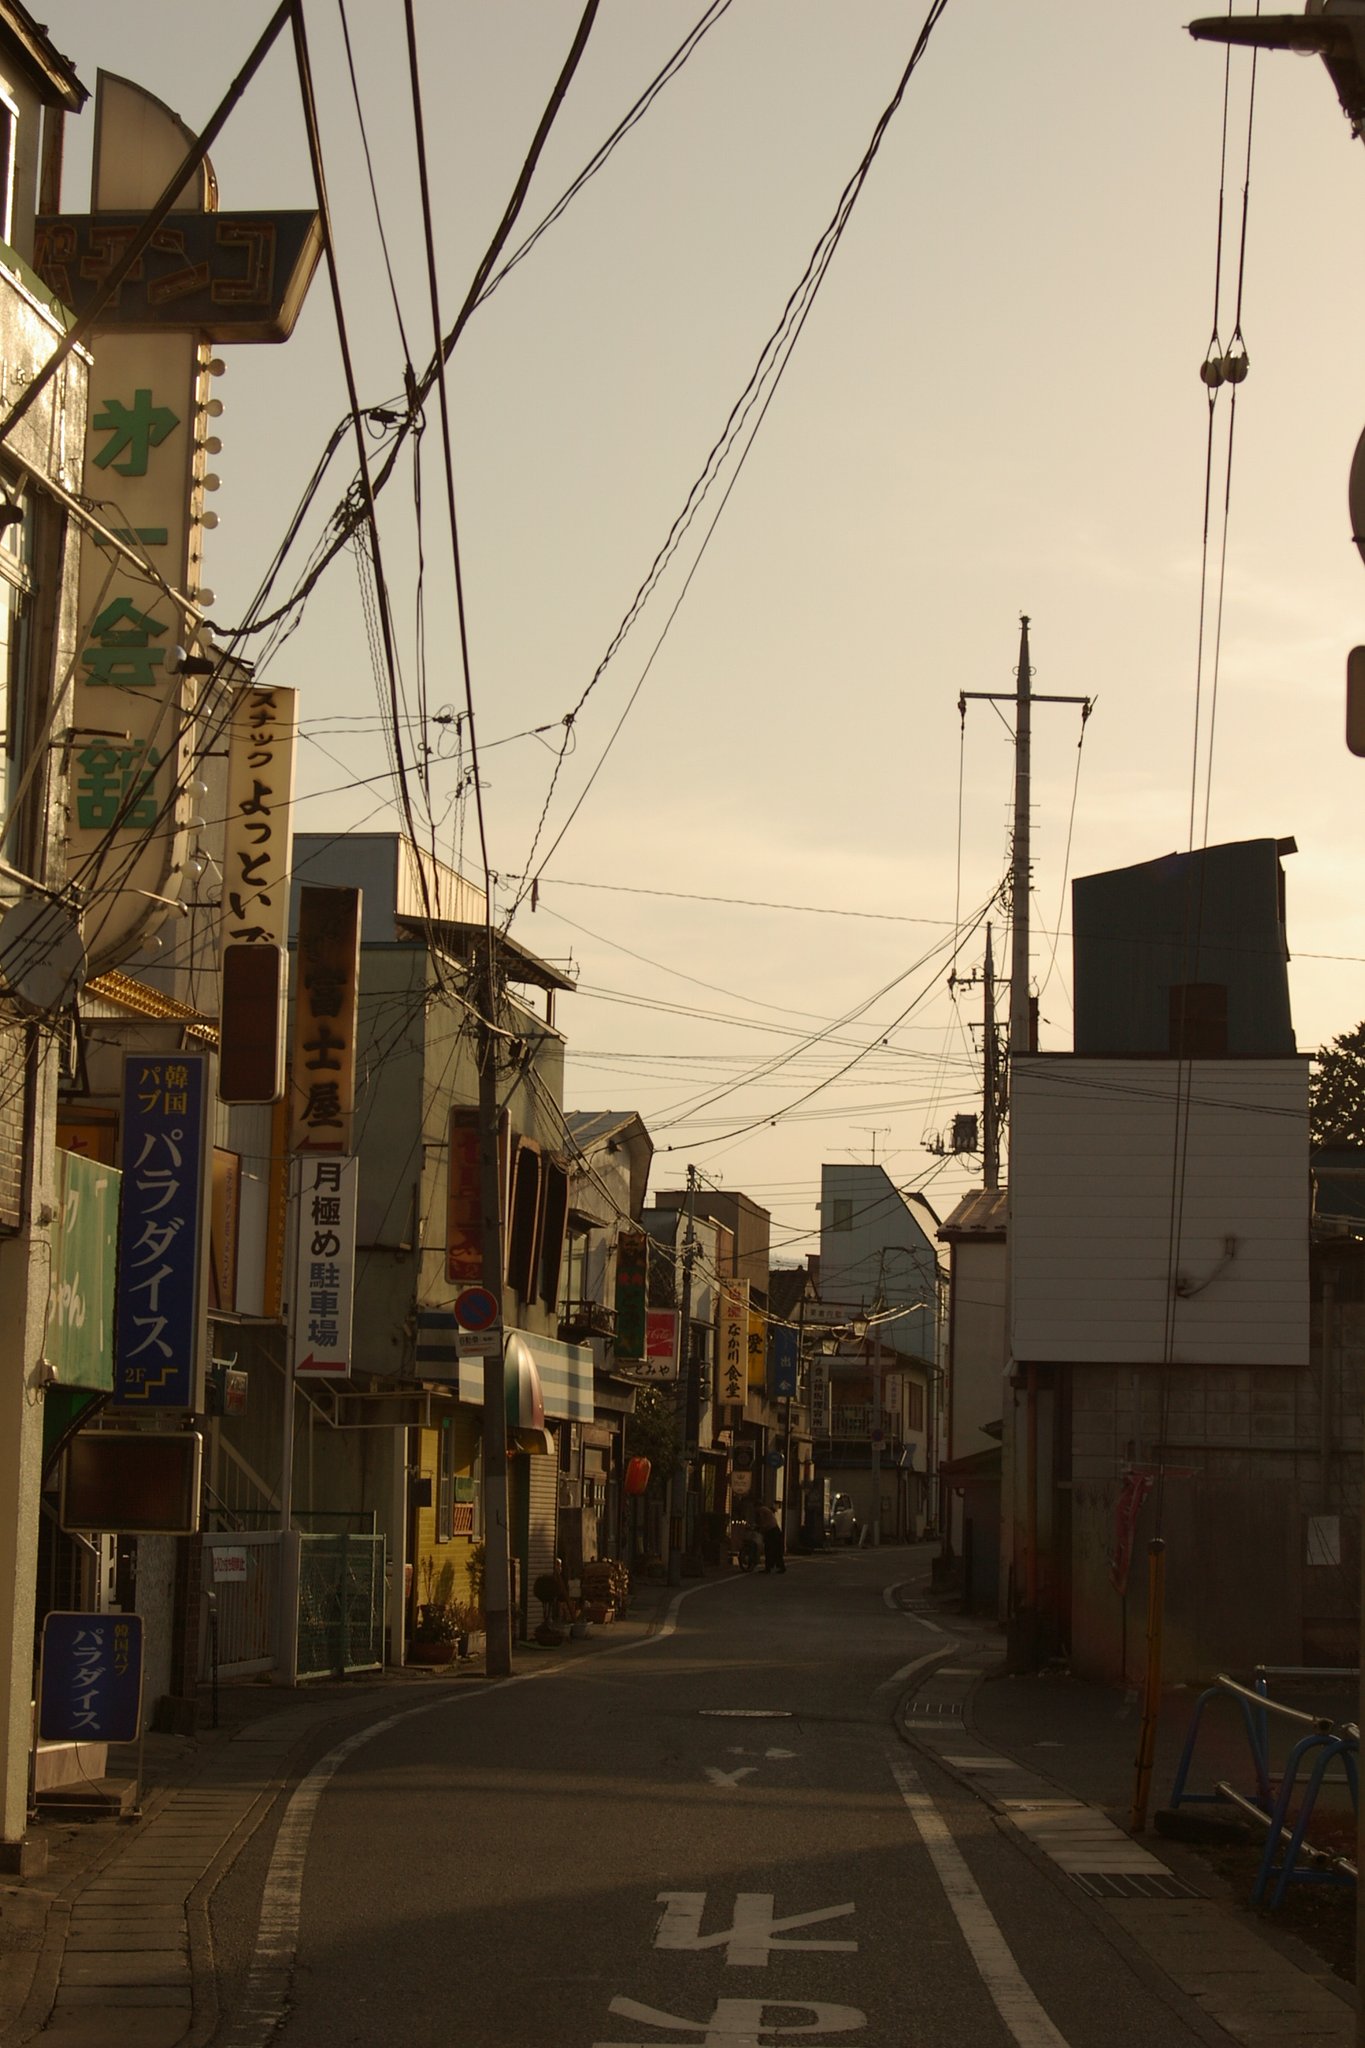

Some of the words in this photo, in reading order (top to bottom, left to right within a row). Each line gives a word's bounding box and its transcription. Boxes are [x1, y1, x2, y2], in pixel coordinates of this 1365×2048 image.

[247, 692, 277, 768] スナック
[164, 1064, 189, 1115] 韓国
[126, 1129, 185, 1359] パラダイス
[307, 1162, 342, 1348] 月極め駐車場
[124, 1367, 147, 1383] 2F
[723, 1322, 743, 1399] なか川食堂
[70, 1629, 107, 1731] パラダイス
